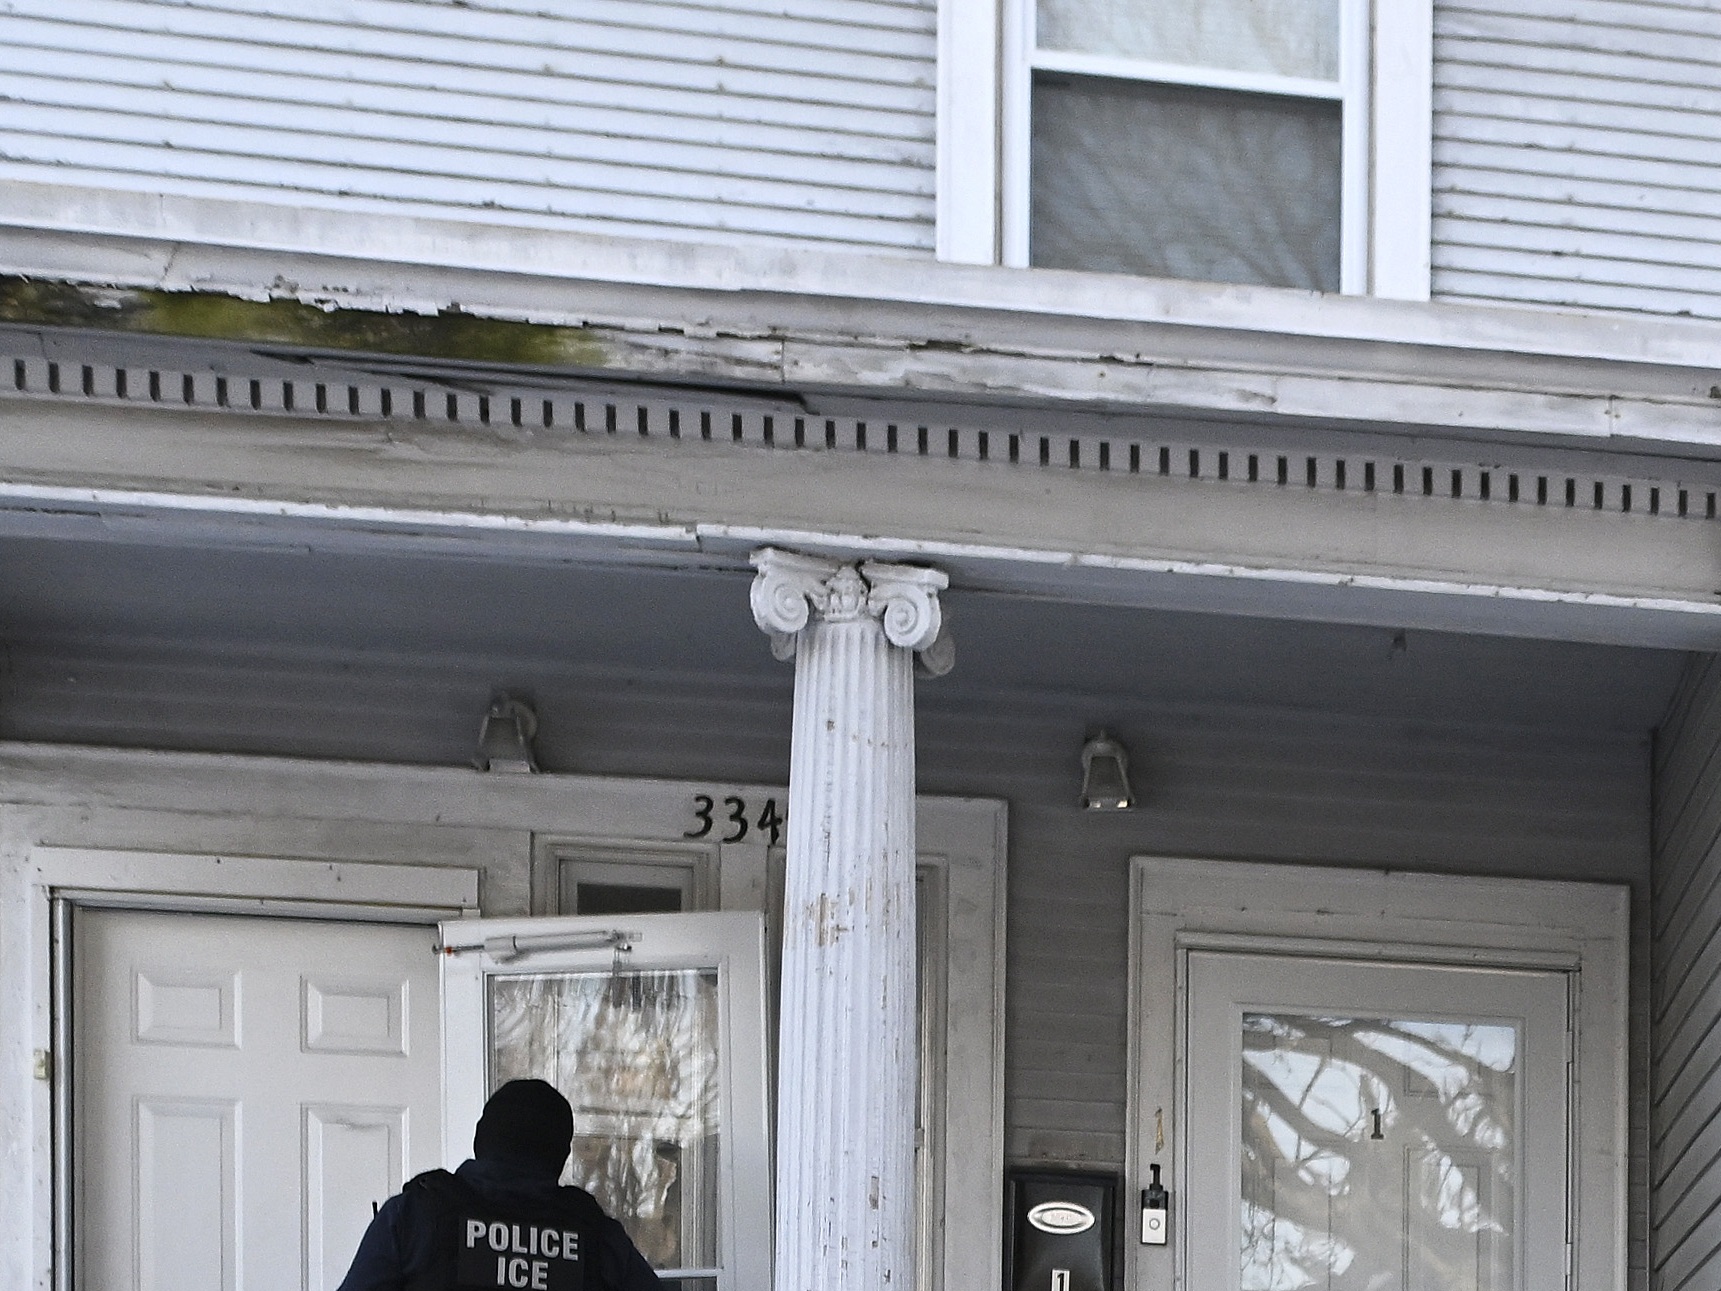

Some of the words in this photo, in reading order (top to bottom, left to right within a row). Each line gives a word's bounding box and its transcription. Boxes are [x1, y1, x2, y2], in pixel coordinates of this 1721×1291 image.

[683, 795, 788, 845] 334
[466, 1219, 580, 1262] POLICE
[497, 1256, 549, 1291] ICE
